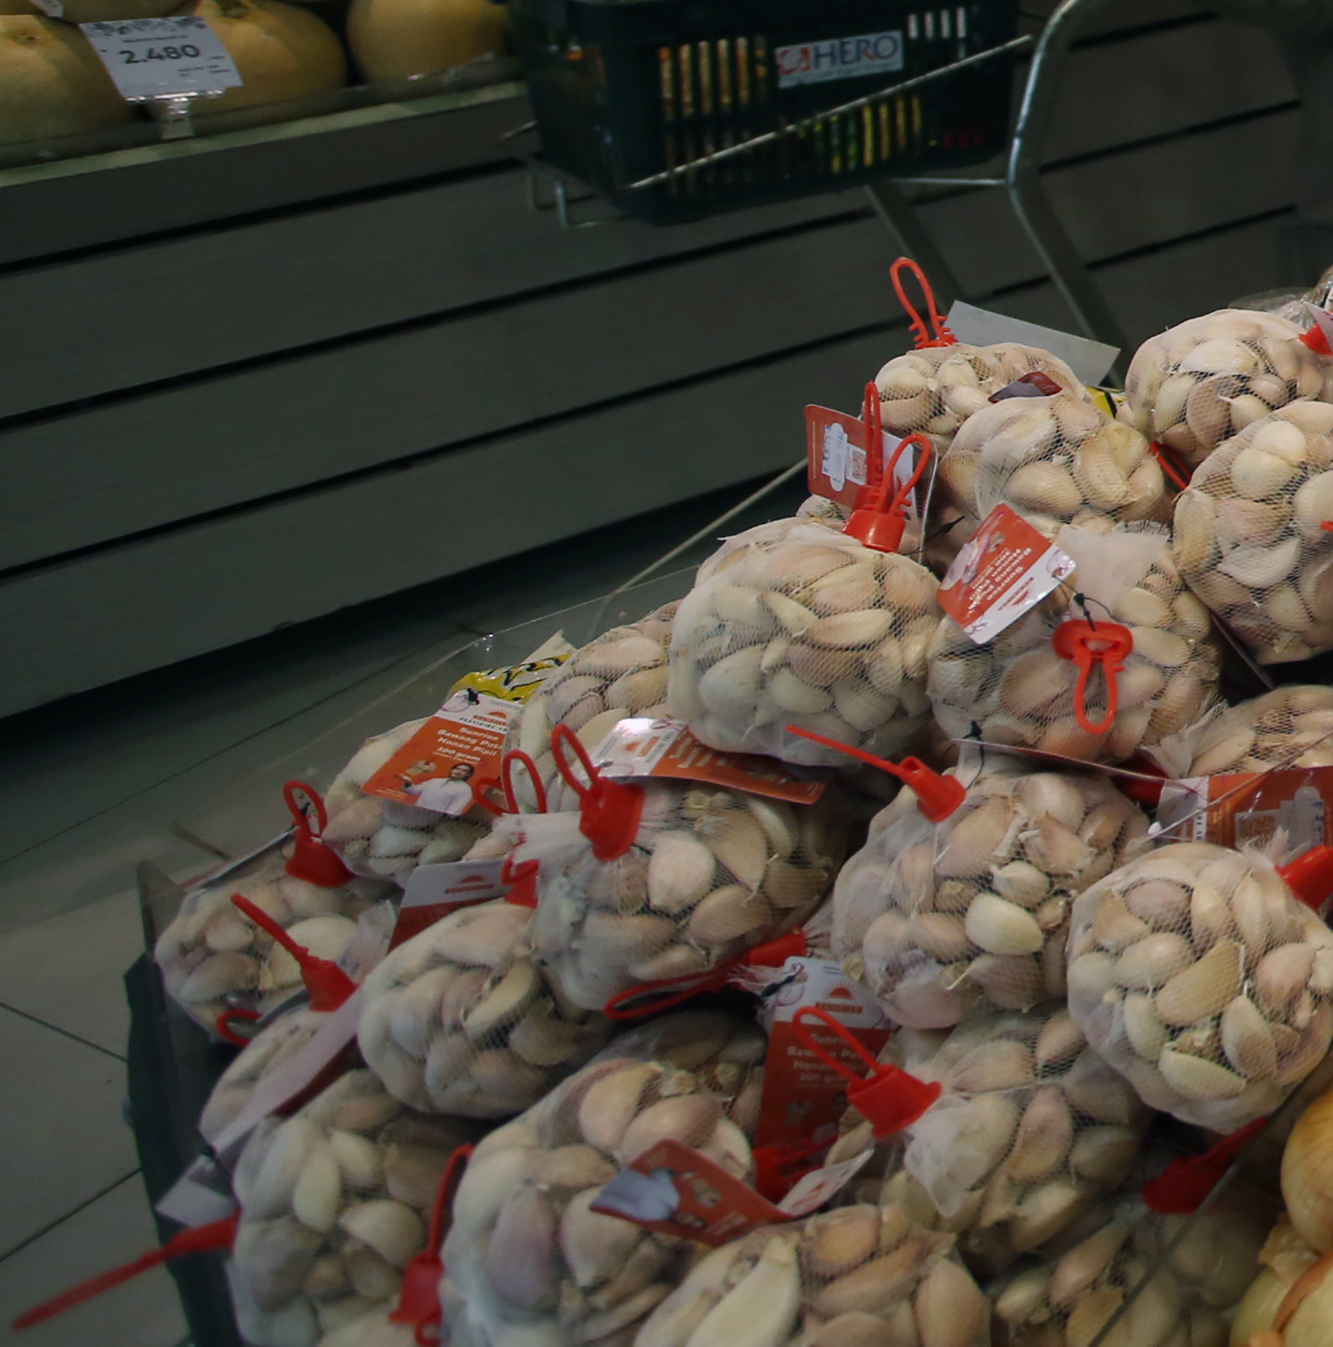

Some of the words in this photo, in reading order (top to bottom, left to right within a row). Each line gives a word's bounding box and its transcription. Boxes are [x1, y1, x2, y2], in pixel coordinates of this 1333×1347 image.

[119, 44, 200, 64] 2.480
[813, 35, 898, 69] HERO
[479, 739, 502, 750] Puti
